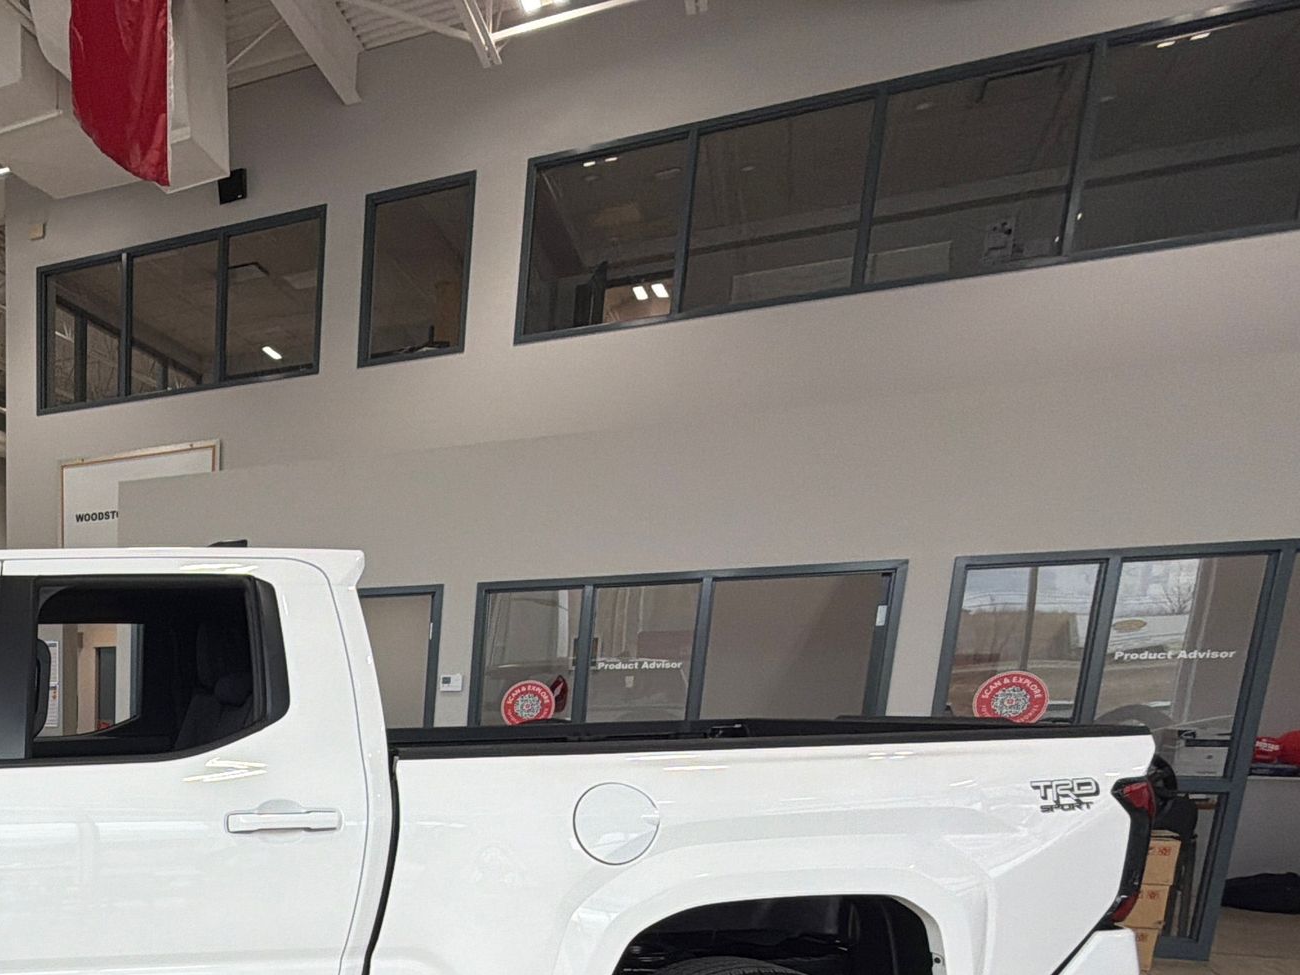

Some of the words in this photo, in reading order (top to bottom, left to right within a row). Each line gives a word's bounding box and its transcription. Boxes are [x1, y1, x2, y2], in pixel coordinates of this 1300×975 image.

[1114, 650, 1174, 660] Product
[1176, 649, 1237, 659] Advisor
[597, 661, 639, 670] Product
[641, 661, 683, 670] Advisor
[507, 688, 521, 704] SCAN
[527, 685, 550, 704] EXPLORE
[981, 679, 1003, 699] SCAN
[1012, 676, 1043, 699] EXPLORE
[1030, 777, 1100, 803] TRD
[1040, 801, 1094, 813] SPORT
